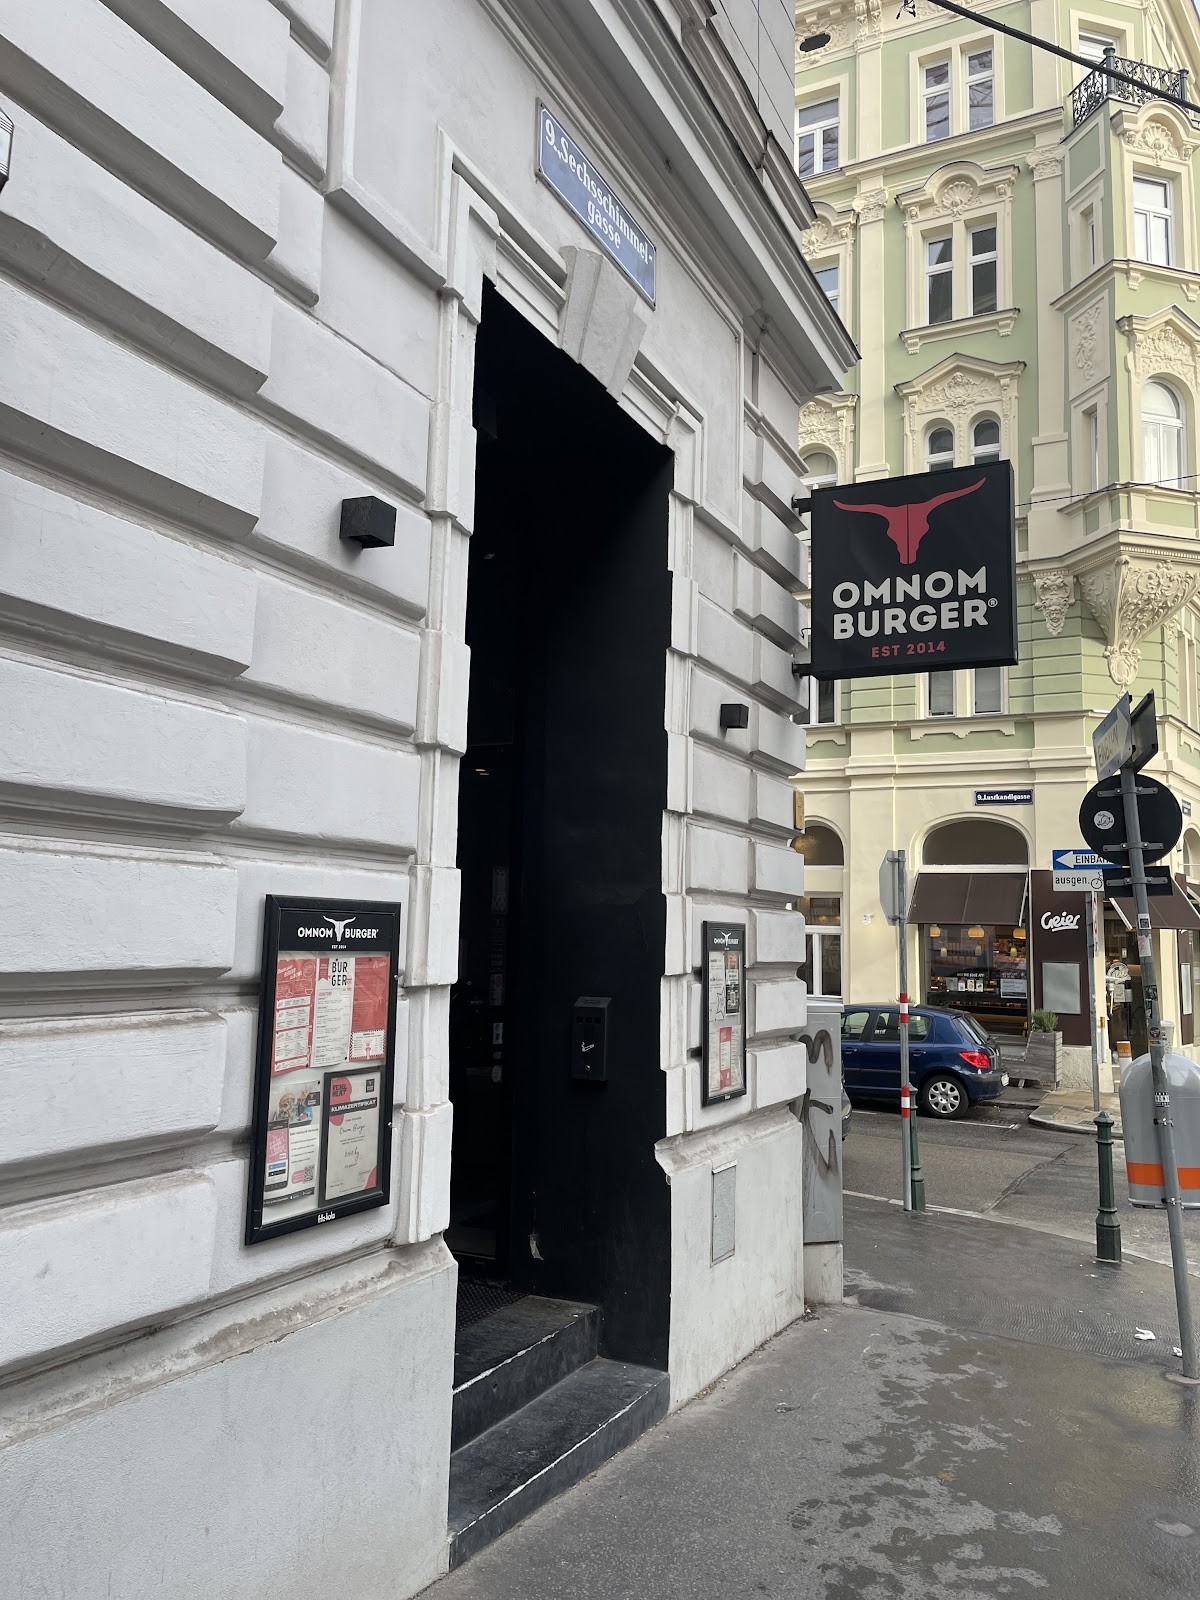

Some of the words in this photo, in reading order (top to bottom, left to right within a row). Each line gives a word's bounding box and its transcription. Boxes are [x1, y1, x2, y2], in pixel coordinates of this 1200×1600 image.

[587, 200, 621, 249] gasse
[832, 565, 987, 609] OMNOM
[871, 644, 900, 658] EST
[906, 641, 946, 655] 2014
[1055, 876, 1090, 886] ausgen.
[1041, 911, 1080, 930] Geier
[297, 927, 333, 938] OMNOM
[331, 961, 348, 973] BUR
[331, 974, 347, 987] GER
